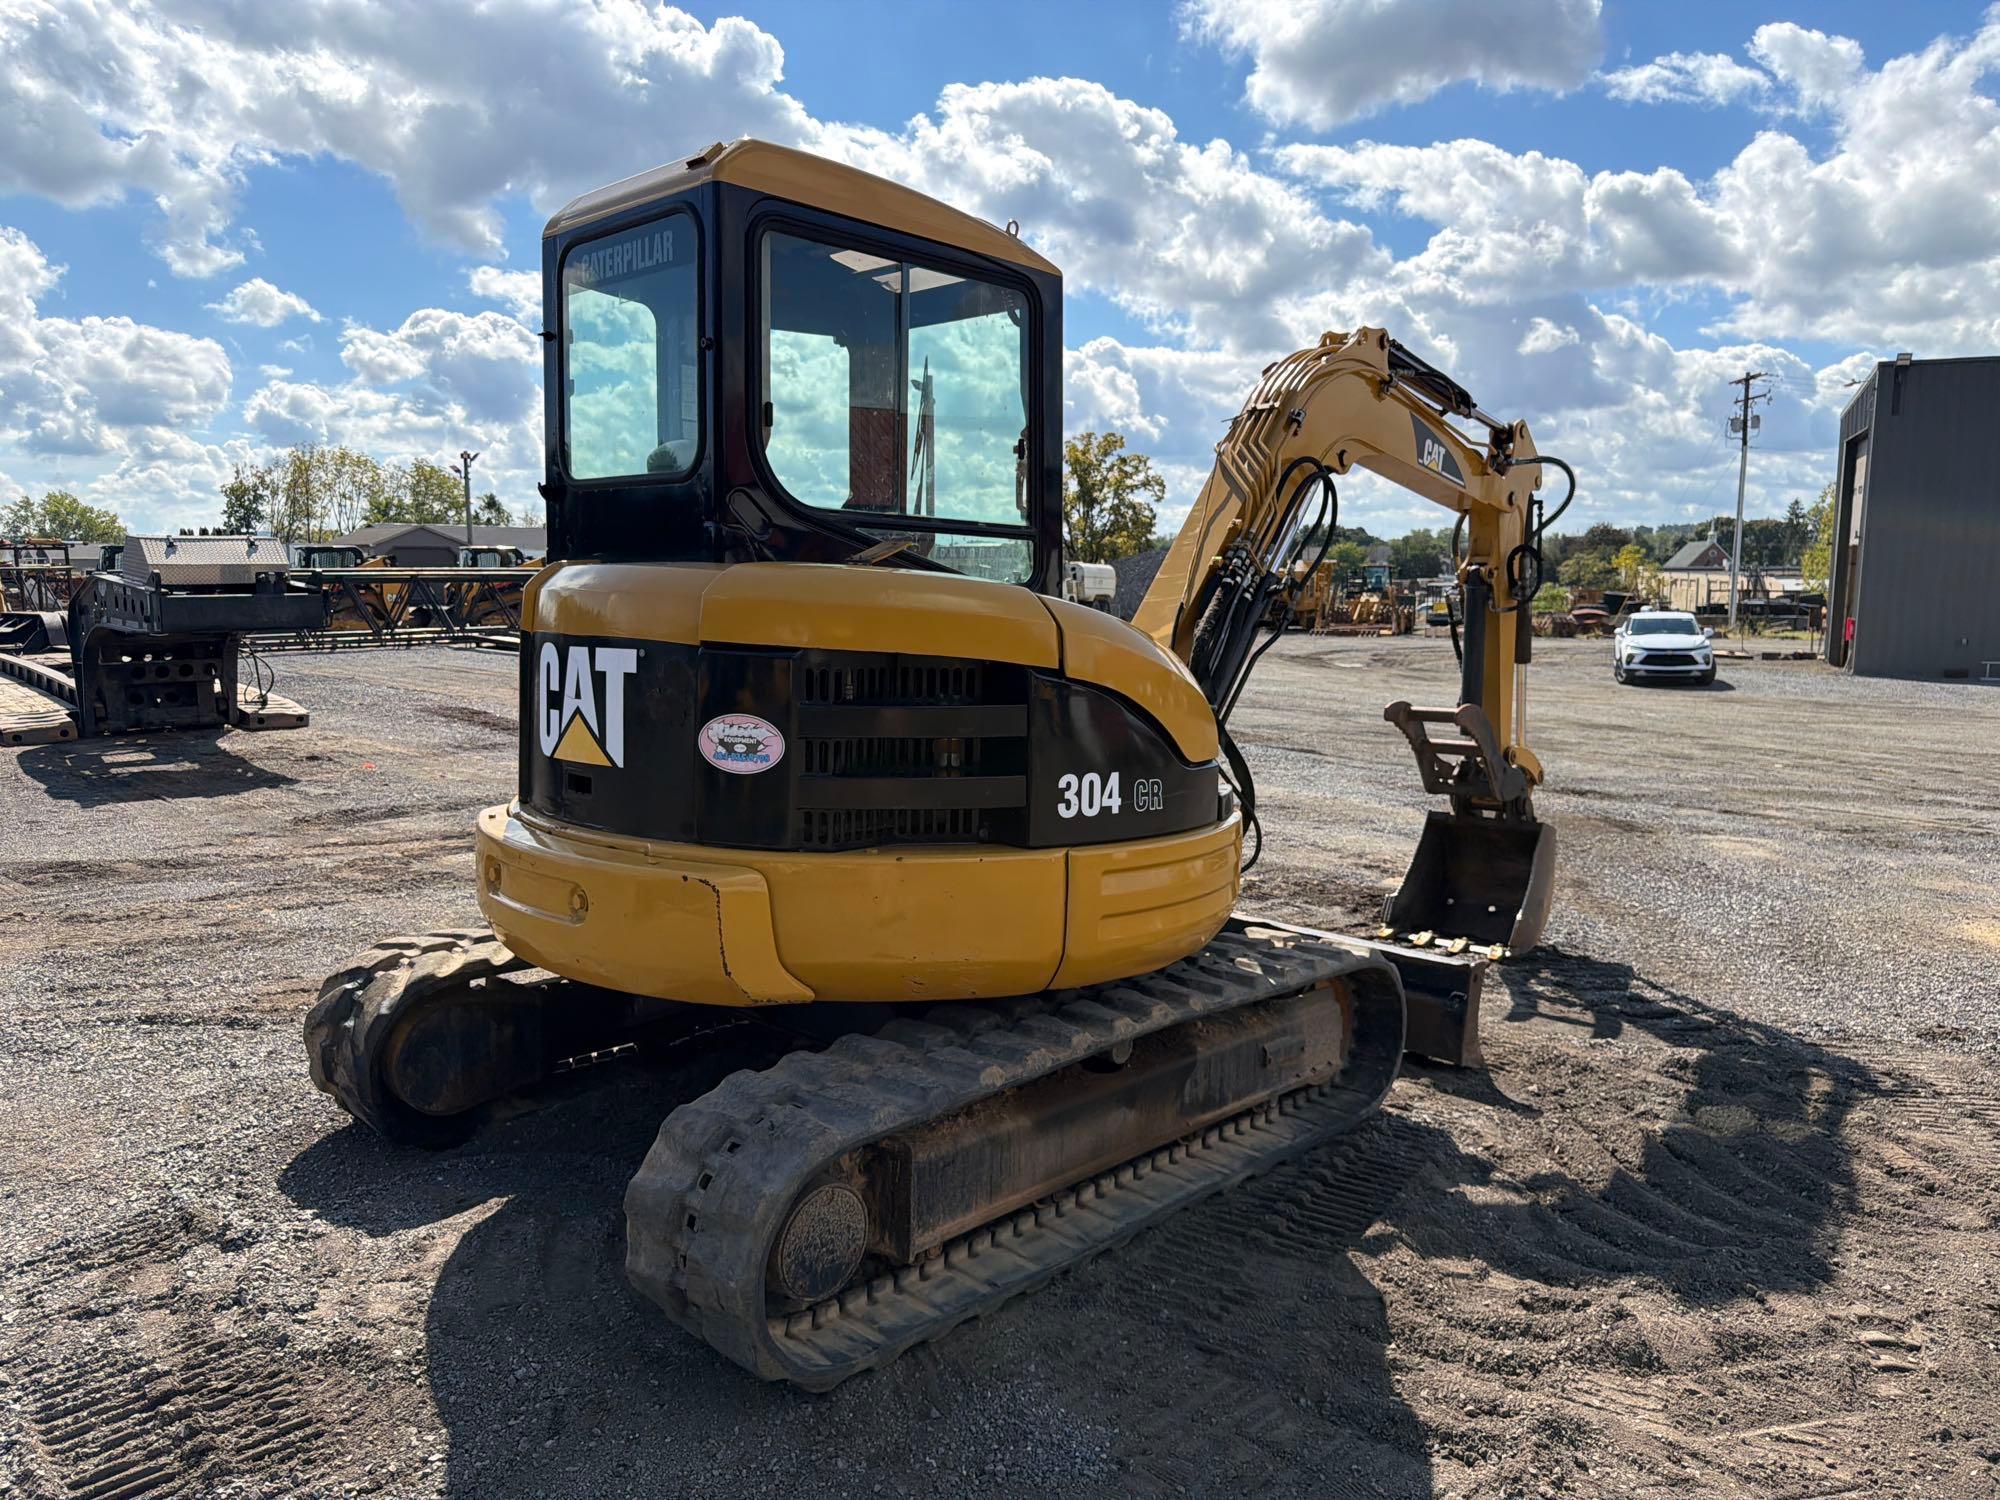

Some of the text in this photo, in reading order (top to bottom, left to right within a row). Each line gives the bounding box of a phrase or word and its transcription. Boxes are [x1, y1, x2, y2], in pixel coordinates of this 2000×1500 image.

[581, 230, 673, 282] CATERPILLAR
[1423, 438, 1446, 473] CAT
[539, 641, 637, 768] CAT
[724, 736, 757, 744] EQUIPMENT
[1057, 771, 1163, 819] 304 CR
